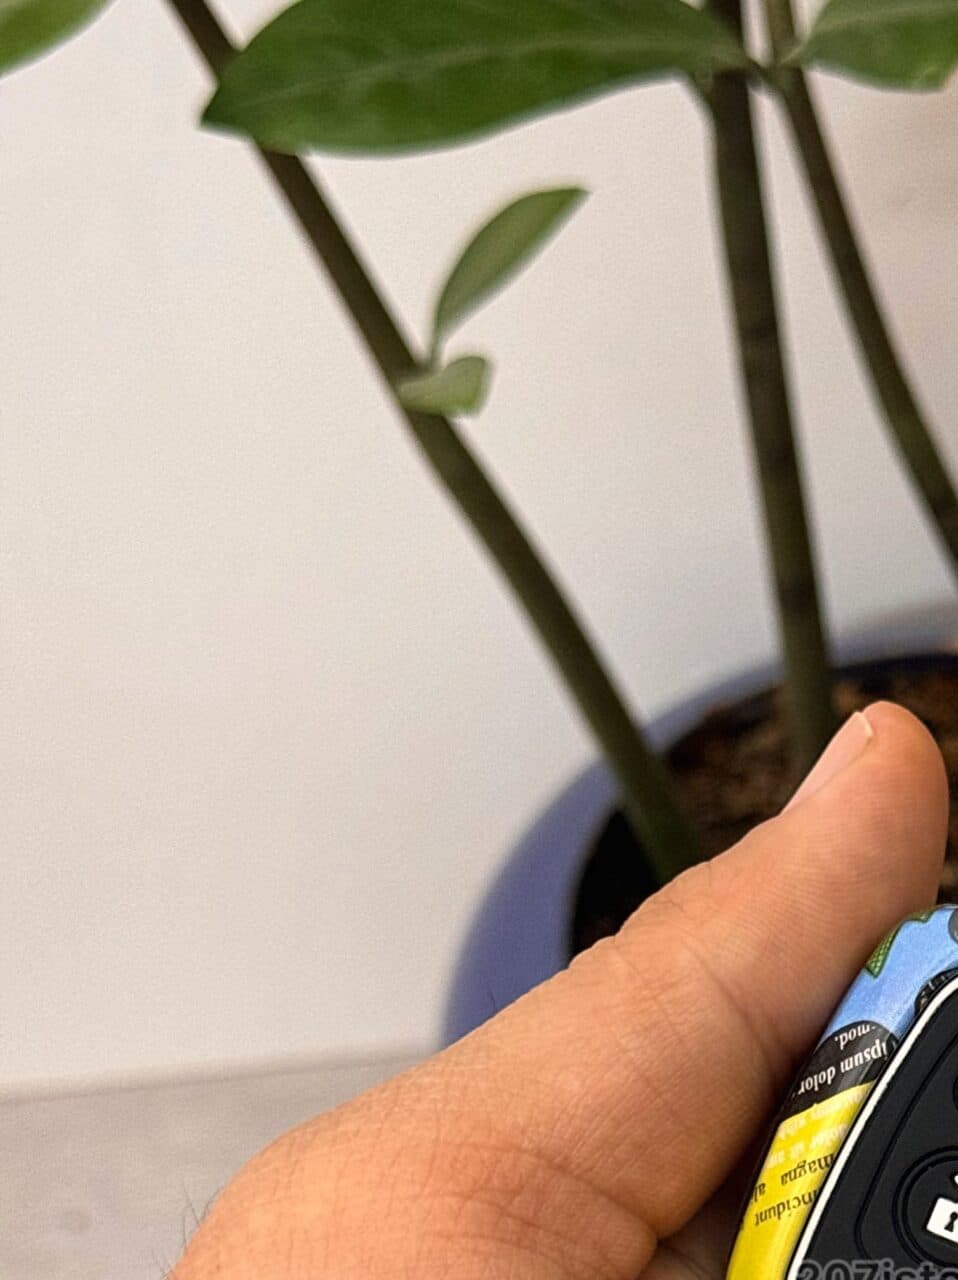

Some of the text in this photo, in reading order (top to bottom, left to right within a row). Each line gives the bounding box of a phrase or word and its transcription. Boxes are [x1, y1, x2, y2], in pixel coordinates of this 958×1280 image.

[798, 1039, 889, 1096] ipsum dolor
[780, 1153, 835, 1186] magna
